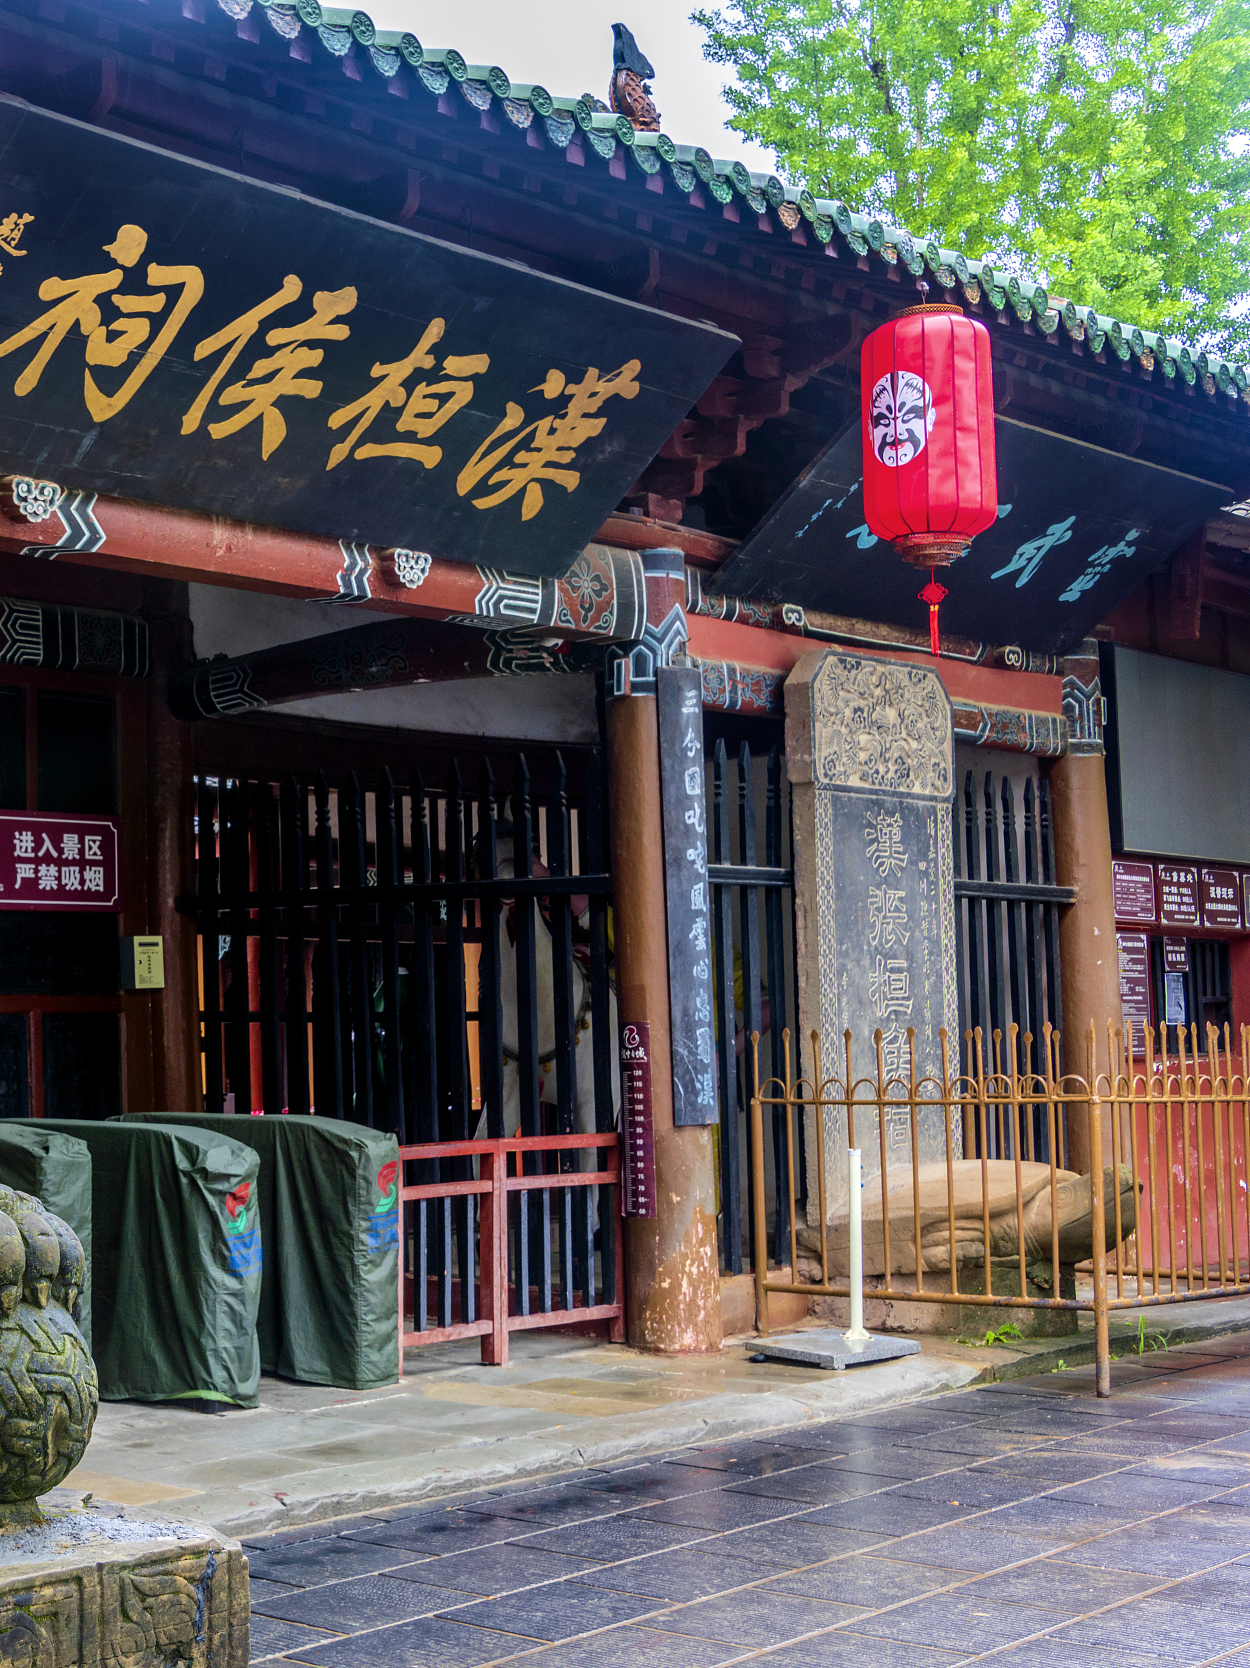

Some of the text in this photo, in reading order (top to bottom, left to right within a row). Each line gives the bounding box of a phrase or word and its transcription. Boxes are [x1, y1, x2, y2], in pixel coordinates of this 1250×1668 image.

[13, 831, 103, 860] 进入景区
[14, 863, 104, 892] 严禁吸烟
